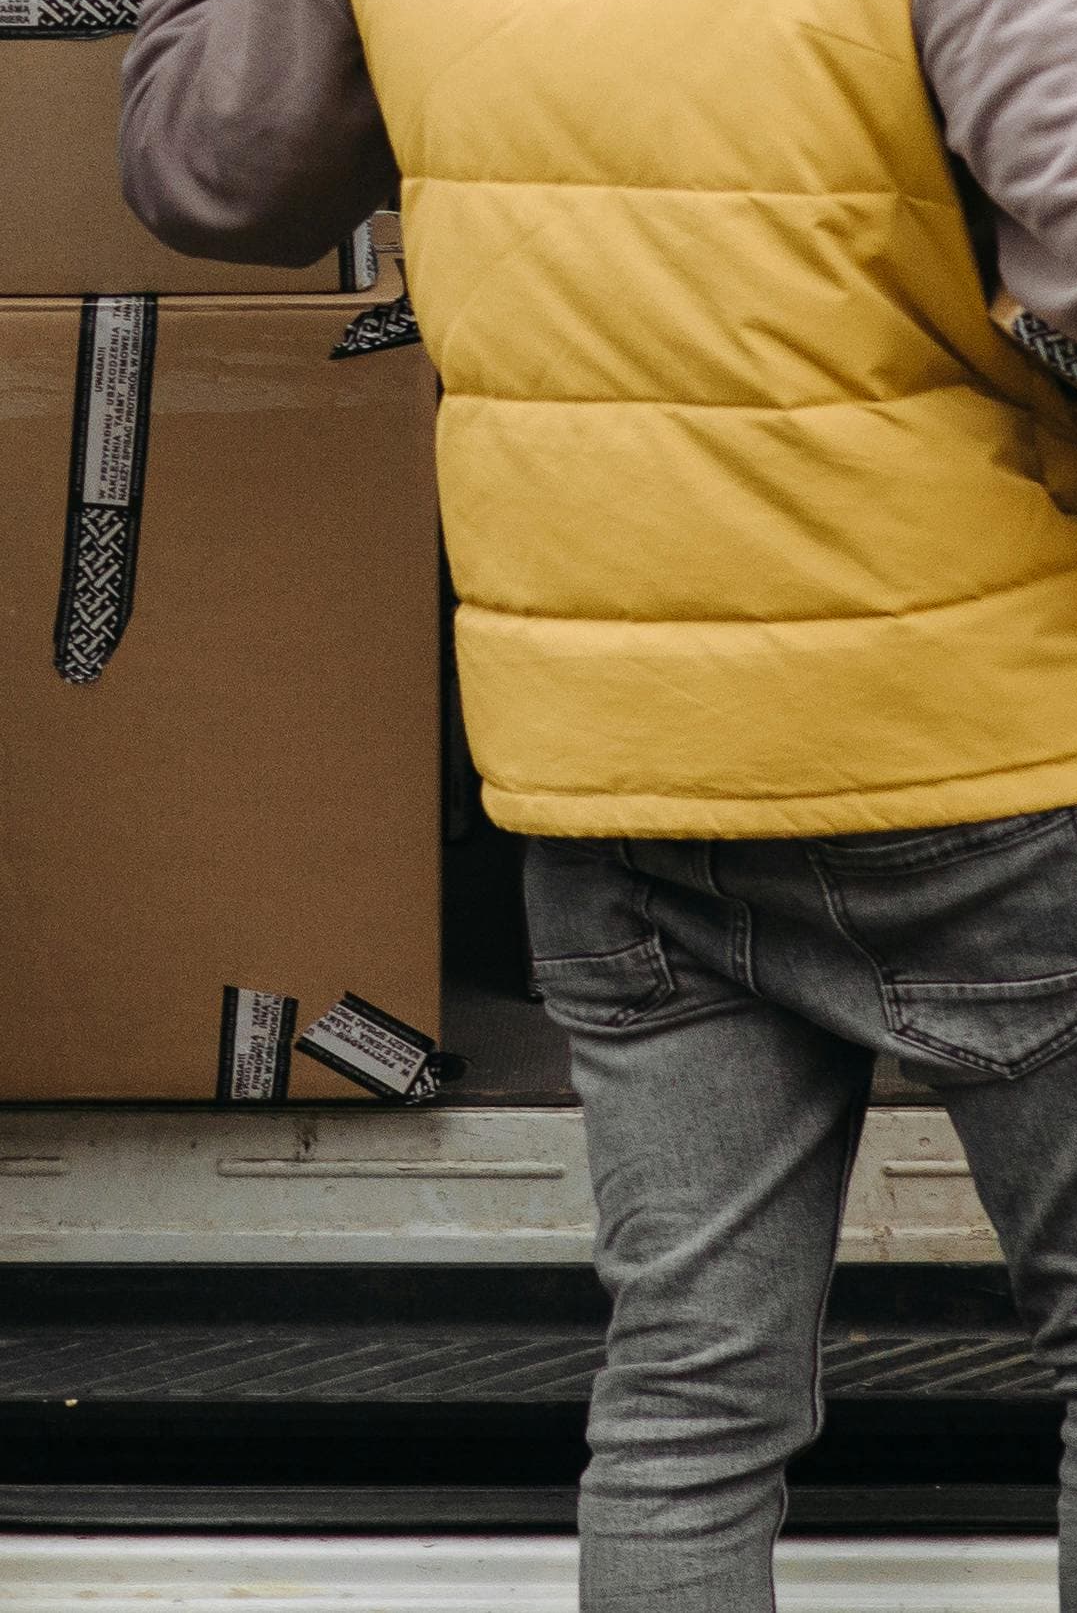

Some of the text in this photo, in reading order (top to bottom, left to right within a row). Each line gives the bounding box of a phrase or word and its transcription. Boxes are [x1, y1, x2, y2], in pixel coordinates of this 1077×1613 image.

[107, 326, 120, 405] USZKODZENIA
[118, 329, 131, 383] FIRMOWEJ
[130, 357, 138, 366] W
[114, 392, 125, 425] TAŚMY
[125, 369, 138, 422] PROTOKÓŁ
[101, 413, 113, 480] PRZYPADKU
[122, 425, 133, 460] SPISAĆ
[108, 435, 121, 500] ZAKLEJENIA
[119, 463, 130, 500] NALEŻY
[99, 490, 107, 498] W
